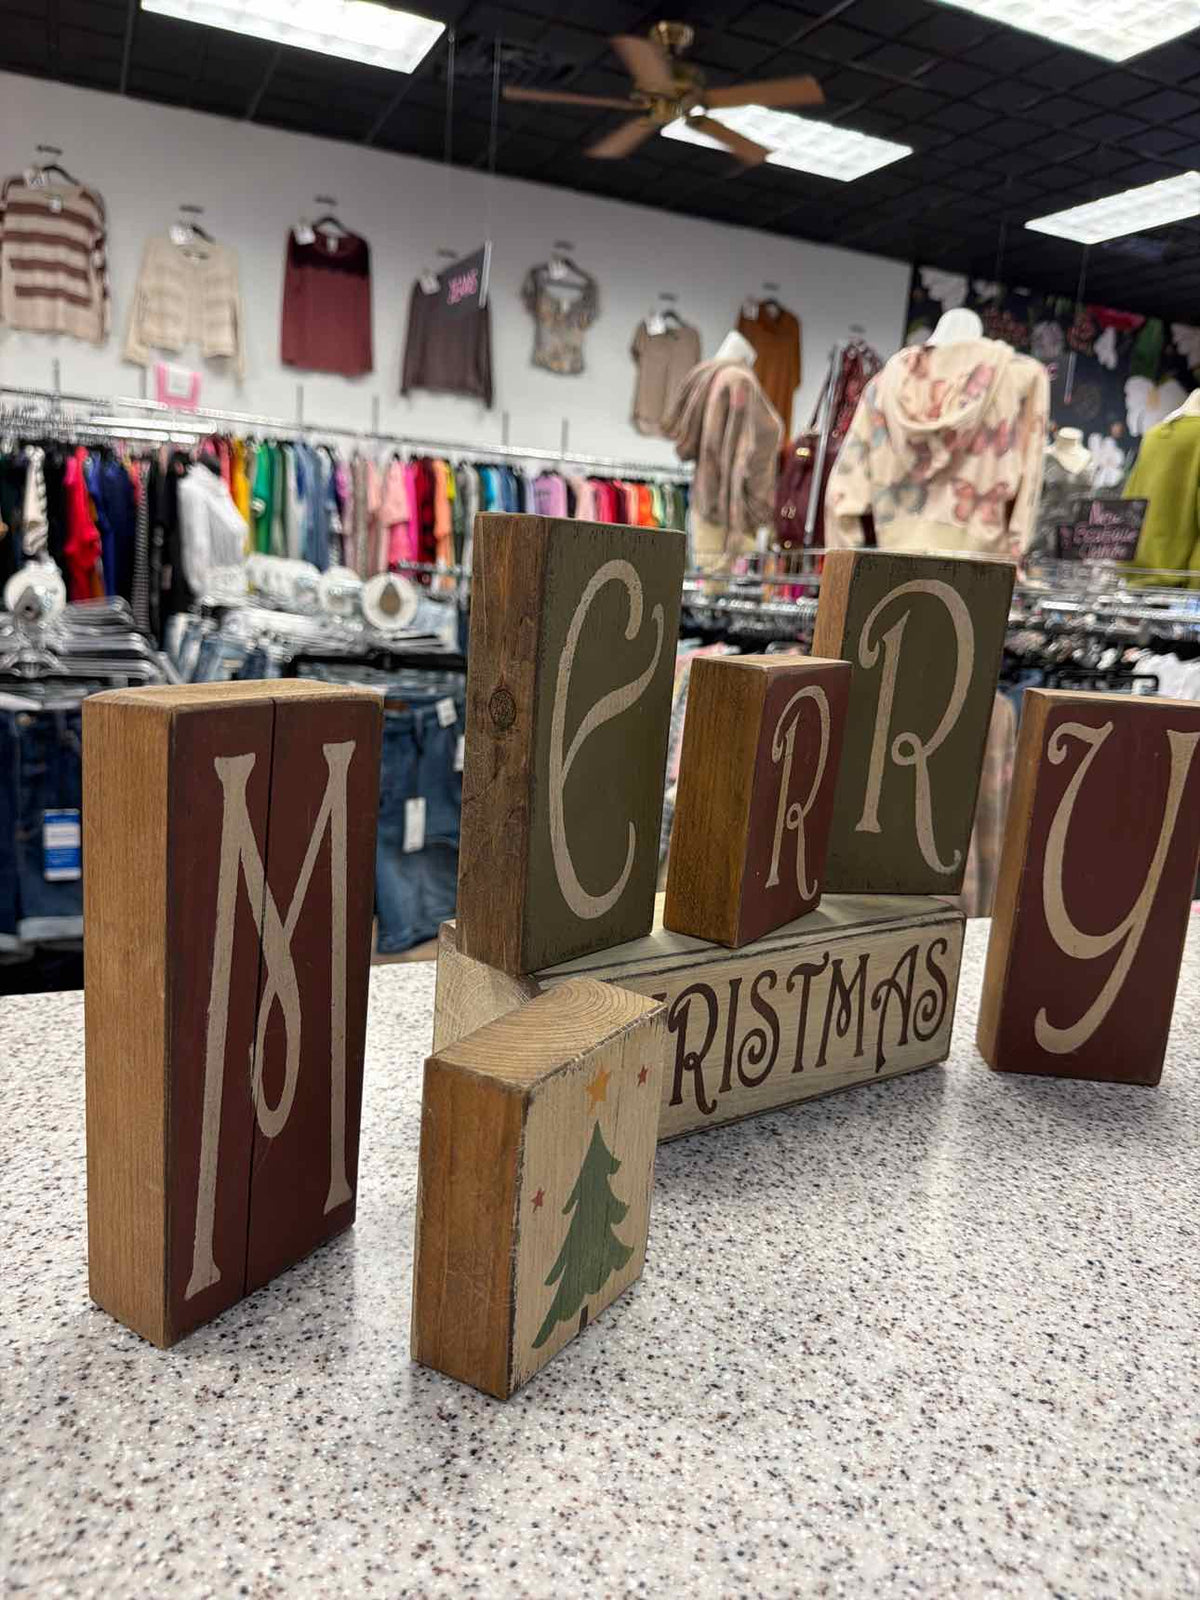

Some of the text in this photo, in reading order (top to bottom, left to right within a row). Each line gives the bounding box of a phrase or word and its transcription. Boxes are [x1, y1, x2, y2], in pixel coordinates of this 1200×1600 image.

[766, 685, 831, 901] R
[855, 579, 973, 874] R
[185, 741, 355, 1299] M
[654, 938, 948, 1115] RISTMAS
